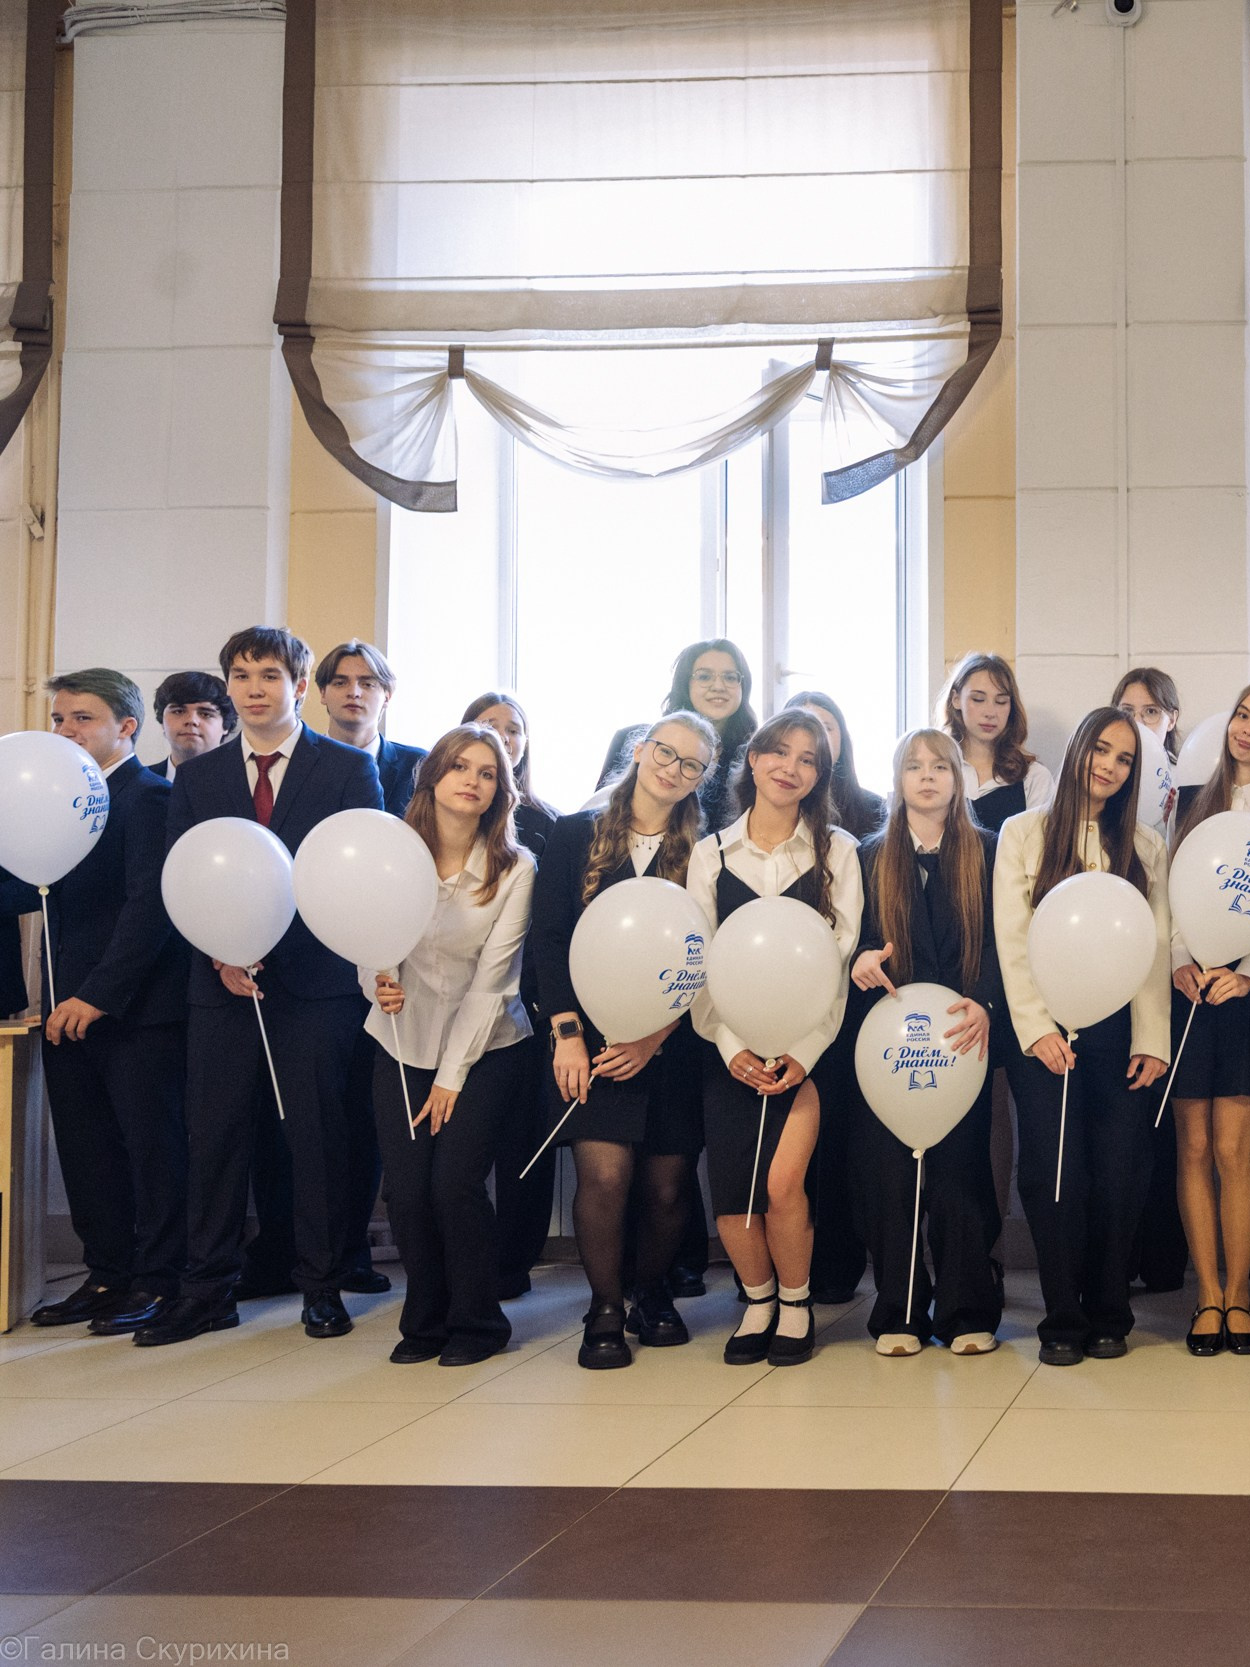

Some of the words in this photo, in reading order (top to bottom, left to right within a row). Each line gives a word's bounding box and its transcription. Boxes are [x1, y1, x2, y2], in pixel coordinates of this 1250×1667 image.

[72, 796, 83, 809] С
[1215, 864, 1229, 875] С
[658, 968, 673, 981] С
[883, 1047, 894, 1060] С
[898, 1046, 942, 1059] Днём
[891, 1055, 957, 1075] знаний!
